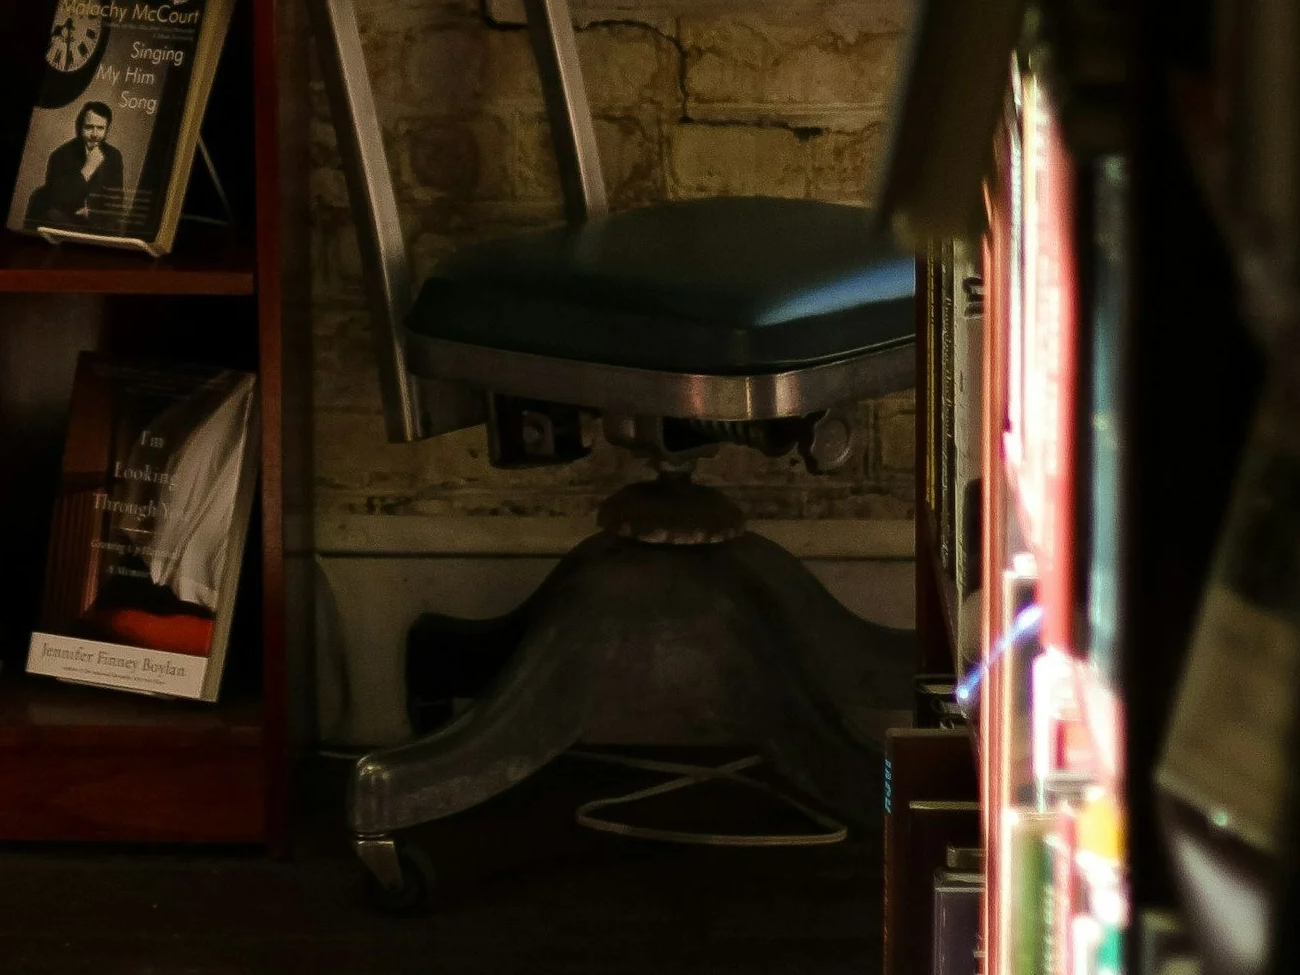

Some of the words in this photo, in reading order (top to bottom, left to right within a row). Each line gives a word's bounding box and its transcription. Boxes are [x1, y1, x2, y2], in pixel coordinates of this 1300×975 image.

[131, 3, 200, 24] McCourt
[130, 40, 184, 66] Singing
[96, 64, 120, 86] My
[124, 65, 155, 85] Him
[120, 90, 157, 115] Song
[41, 642, 94, 663] Jennifer
[97, 651, 138, 672] Finney
[142, 657, 186, 677] Boylan
